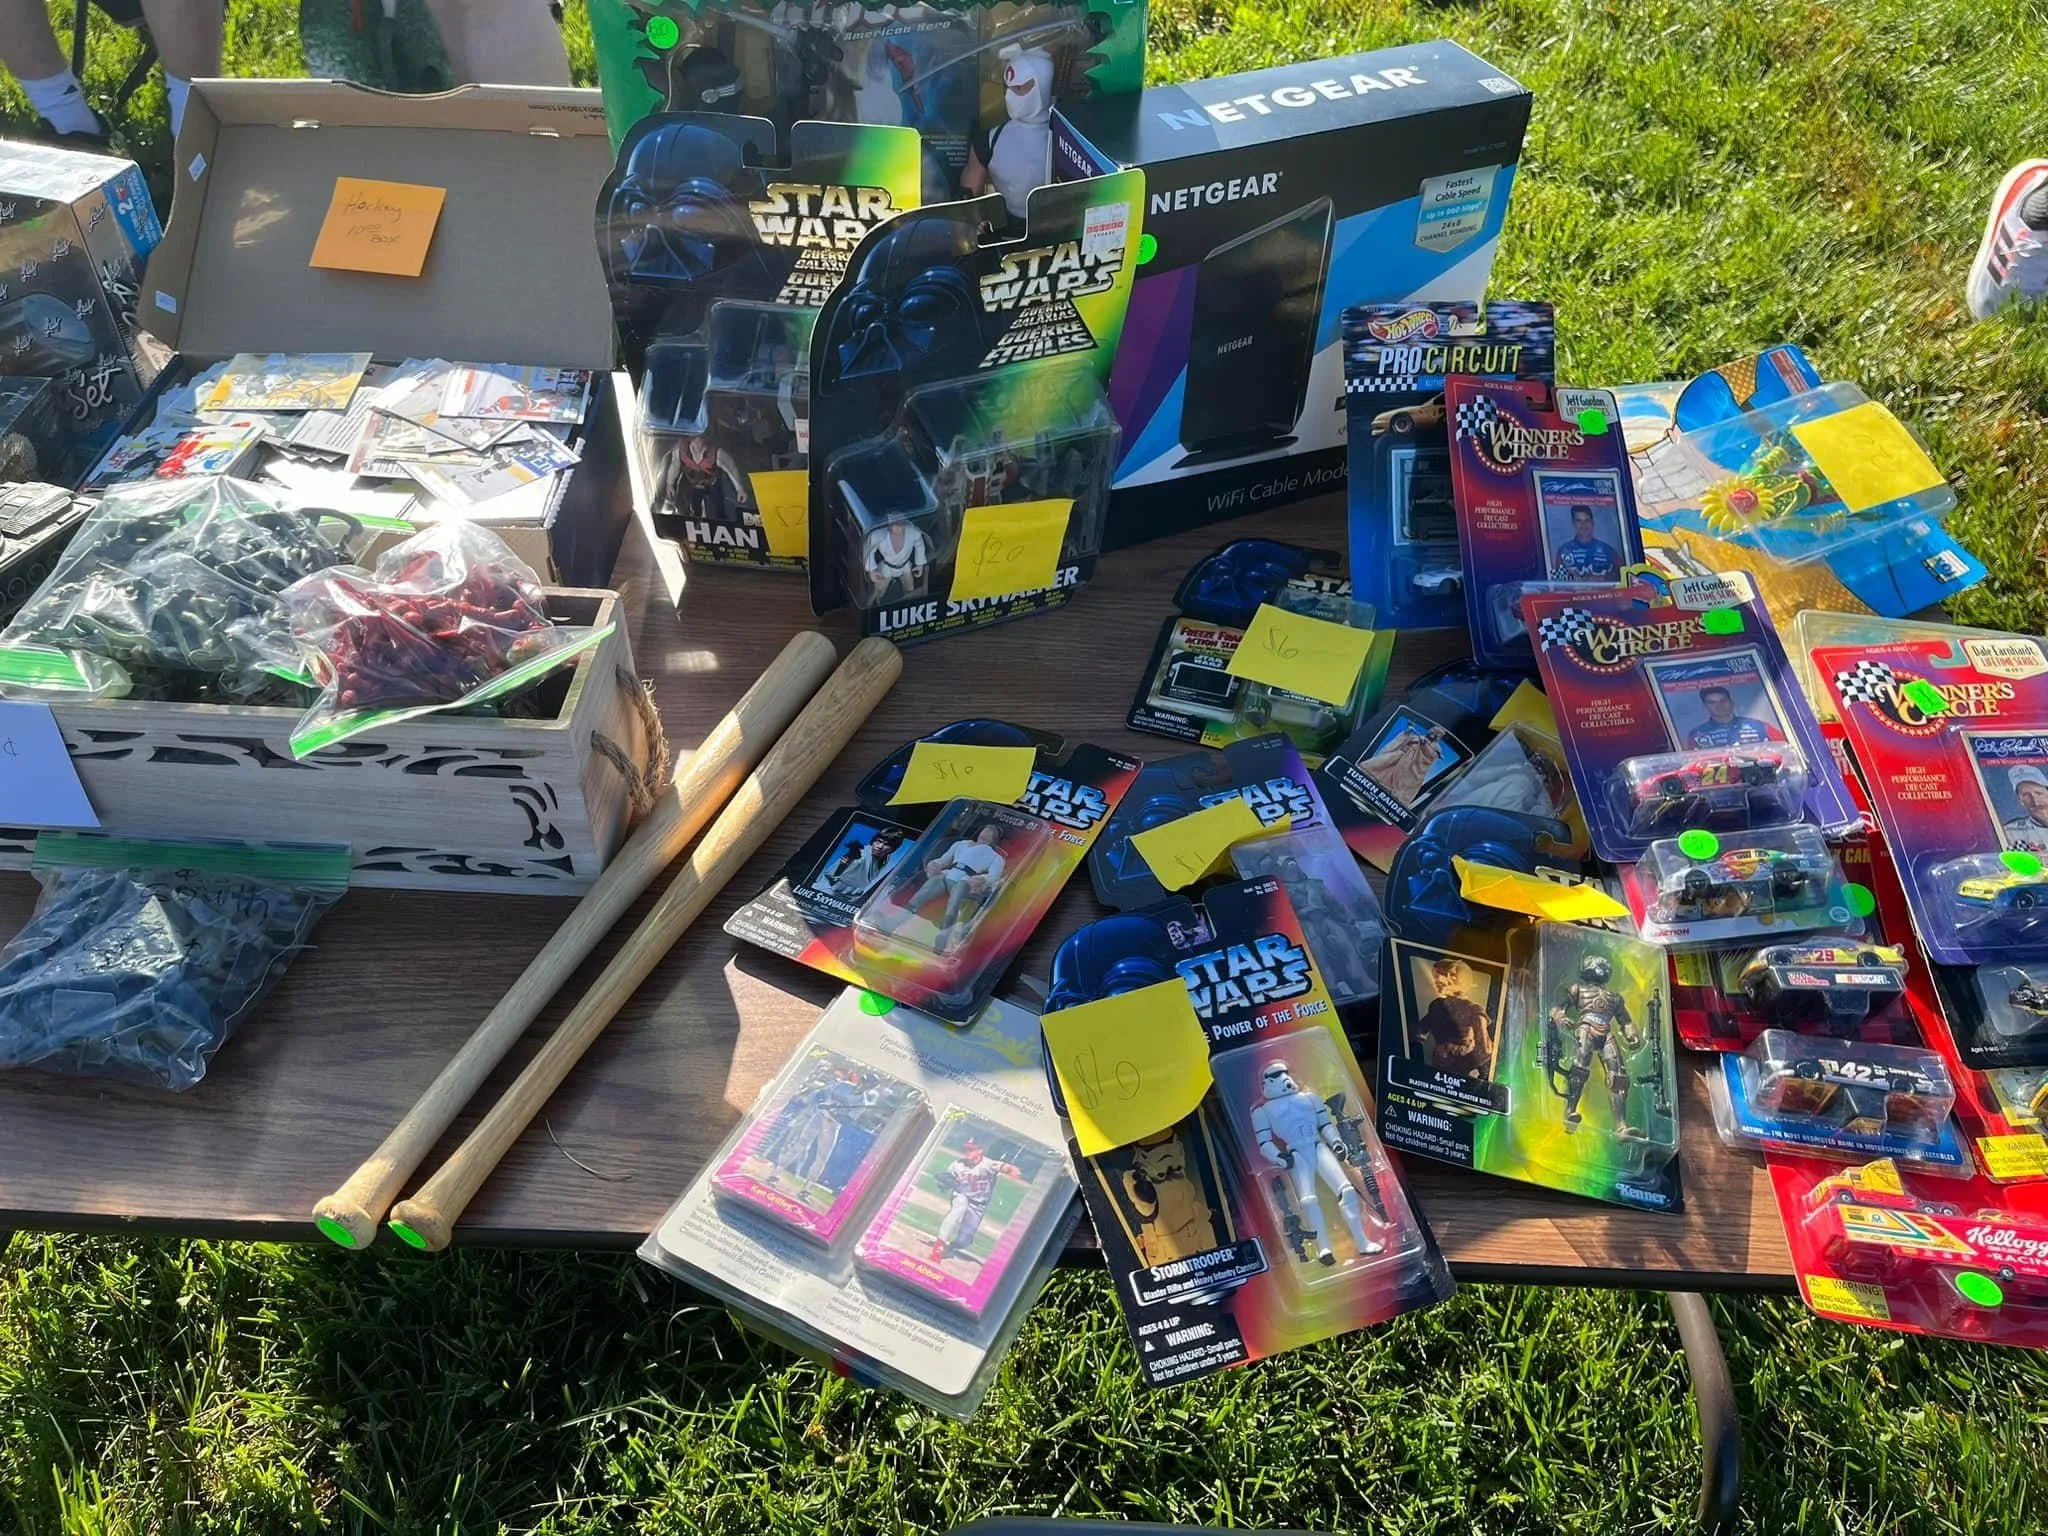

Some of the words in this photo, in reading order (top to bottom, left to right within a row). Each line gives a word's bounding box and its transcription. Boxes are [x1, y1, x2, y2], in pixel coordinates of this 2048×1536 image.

[843, 26, 911, 42] American
[916, 20, 951, 32] Hero
[1157, 66, 1430, 131] NETGEAR
[1058, 135, 1093, 177] NETGEAR
[1151, 173, 1280, 215] NETGEAR
[1435, 190, 1456, 202] Cable
[1458, 185, 1482, 198] Speed
[1446, 177, 1473, 189] Fastest
[345, 192, 402, 223] Hockey
[749, 182, 903, 221] STAR
[751, 214, 867, 250] WAR
[1420, 231, 1448, 242] CHANNEL
[980, 262, 1121, 312] WARS
[998, 321, 1084, 346] GUERRE
[1217, 335, 1254, 355] NETGEAR
[1378, 346, 1423, 375] PRO
[1425, 344, 1523, 374] CIRCUIT
[1566, 394, 1580, 406] Jeff
[1580, 395, 1606, 408] Gordon
[1481, 421, 1585, 447] WINNER'S
[1493, 440, 1569, 464] CIRCLE
[1207, 487, 1246, 513] WiFi
[1249, 473, 1299, 501] Cable
[685, 520, 760, 549] HAN
[973, 532, 1025, 577] $20
[1683, 580, 1700, 594] Jeff
[1701, 577, 1736, 592] Gordon
[879, 600, 938, 632] LUKE
[1593, 633, 1694, 665] CIRCLE
[1972, 645, 1992, 657] Dale
[1992, 643, 2034, 656] Earnhardt
[1981, 656, 2015, 667] LIFETIME
[2015, 655, 2039, 667] SERIES
[1576, 703, 1632, 714] PERFORMANCE
[1591, 697, 1611, 706] HIGH
[1580, 717, 1635, 728] COLLECTIBLES
[1346, 767, 1379, 794] TUSKEN
[1702, 765, 1729, 787] 24
[1891, 773, 1947, 783] PERFORMANCE
[1905, 766, 1926, 775] HIGH
[1026, 771, 1110, 812] TAR
[1897, 790, 1952, 800] COLLECTIBLES
[1013, 791, 1102, 830] ARS
[1378, 792, 1409, 819] RAIDER
[792, 884, 814, 901] LUKE
[813, 892, 861, 915] SKYWALKER
[1815, 950, 1836, 962] 29
[1211, 1022, 1253, 1041] POWER
[1255, 1014, 1269, 1028] OF
[1271, 1009, 1293, 1026] THE
[1293, 1000, 1329, 1019] FORCE
[1434, 1071, 1461, 1088] 4-LOM
[1840, 1061, 1872, 1080] 42
[1001, 1097, 1039, 1119] Baseball
[1020, 1095, 1045, 1112] Cards
[1387, 1092, 1405, 1104] AGES
[1416, 1100, 1428, 1109] UP
[1385, 1122, 1412, 1138] CHOKING
[1407, 1110, 1452, 1132] WARNING:
[1385, 1131, 1395, 1141] Not
[1395, 1133, 1404, 1143] for
[1405, 1135, 1428, 1149] children
[1428, 1141, 1445, 1153] under
[750, 1183, 767, 1197] Ken
[1615, 1182, 1667, 1206] Kenner
[1150, 1248, 1235, 1282] STORMTROOPER
[1167, 1280, 1184, 1294] Rifle
[1184, 1278, 1195, 1290] and
[1195, 1273, 1214, 1287] Heavy
[1831, 1279, 1883, 1297] WARNING:
[1170, 1316, 1181, 1328] UP
[1165, 1322, 1216, 1347] WARNING:
[1149, 1354, 1179, 1372] CHOKING
[1152, 1369, 1165, 1382] Not
[1165, 1367, 1175, 1379] for
[1175, 1361, 1200, 1378] children
[1200, 1356, 1217, 1370] under
